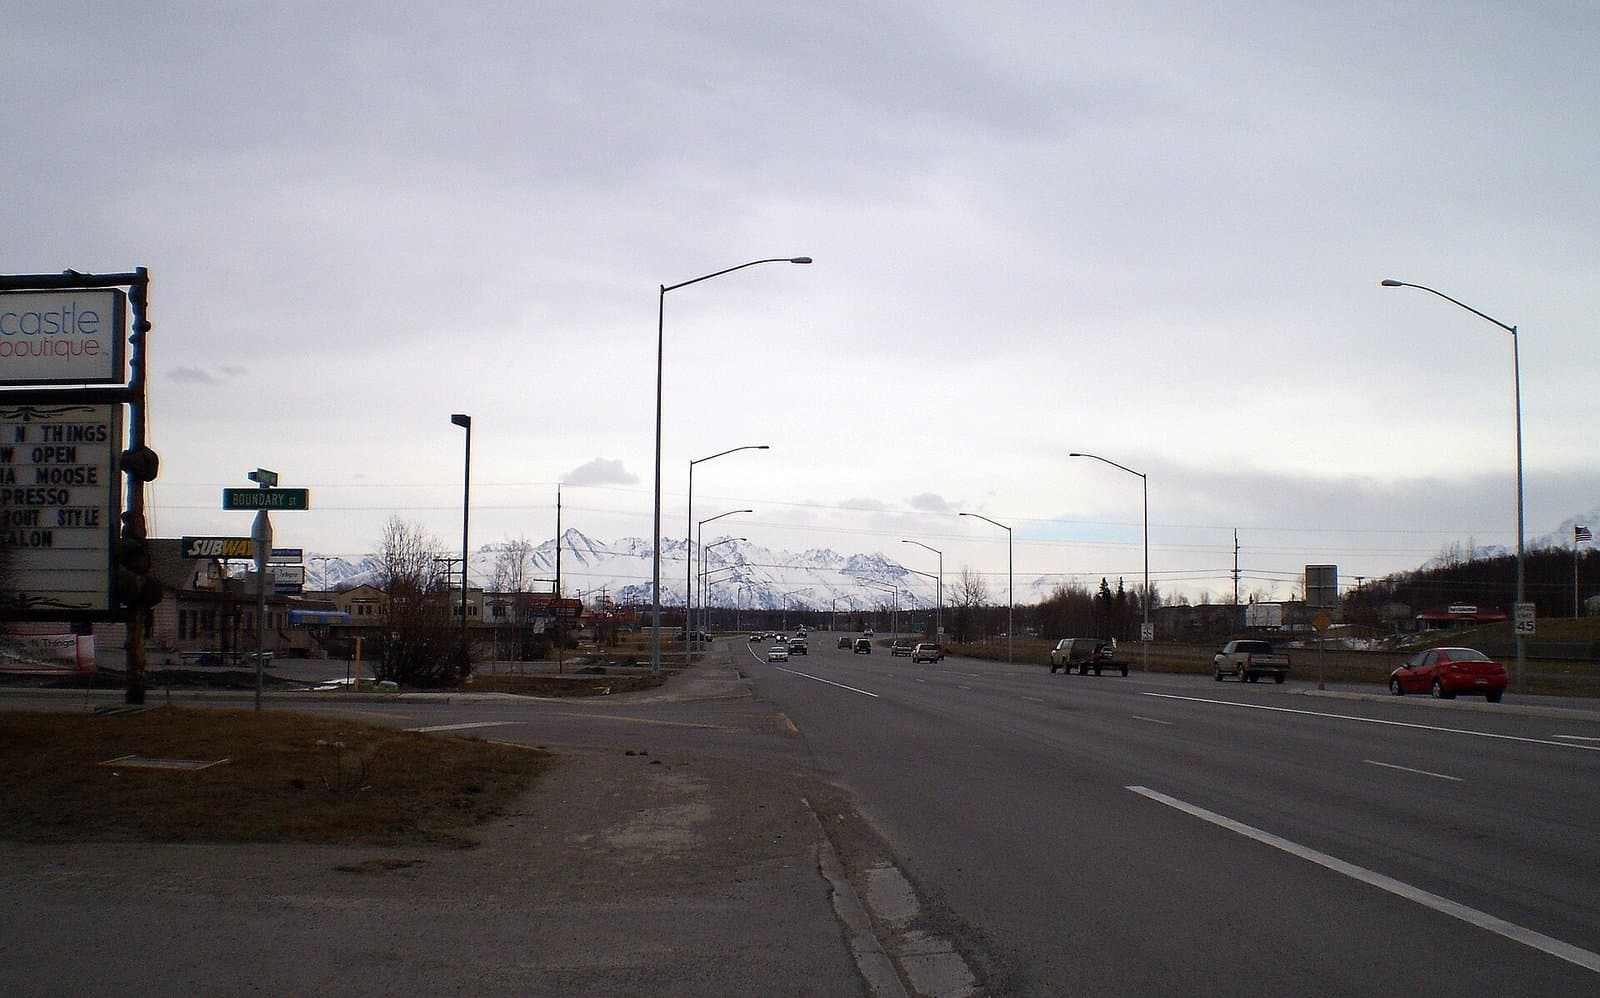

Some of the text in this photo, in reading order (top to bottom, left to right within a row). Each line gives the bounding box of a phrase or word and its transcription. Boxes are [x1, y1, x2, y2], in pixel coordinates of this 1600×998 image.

[0, 302, 100, 336] castle
[15, 425, 108, 442] N THINGS
[32, 446, 76, 463] OPEN
[36, 468, 97, 484] MOOSE
[2, 488, 69, 505] PRESSO
[233, 493, 284, 506] BOUNDARY
[57, 510, 99, 526] STYLE
[187, 539, 252, 556] SUBWA
[1517, 620, 1534, 632] 45
